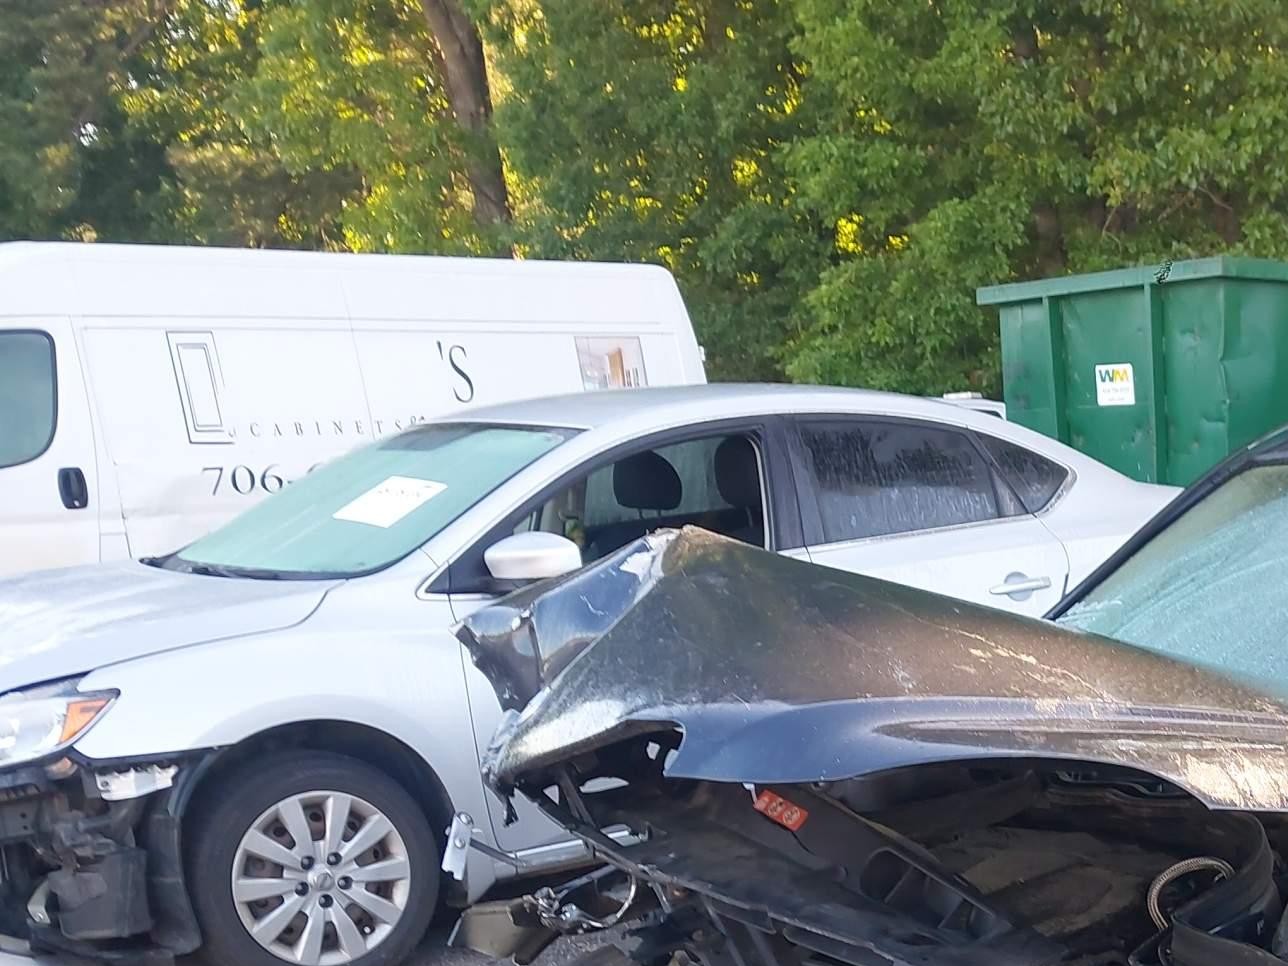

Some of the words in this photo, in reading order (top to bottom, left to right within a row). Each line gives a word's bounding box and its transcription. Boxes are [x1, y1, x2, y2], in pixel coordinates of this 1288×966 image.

[1098, 368, 1130, 383] WM
[249, 415, 404, 438] CABINETS
[201, 462, 324, 496] 706-
